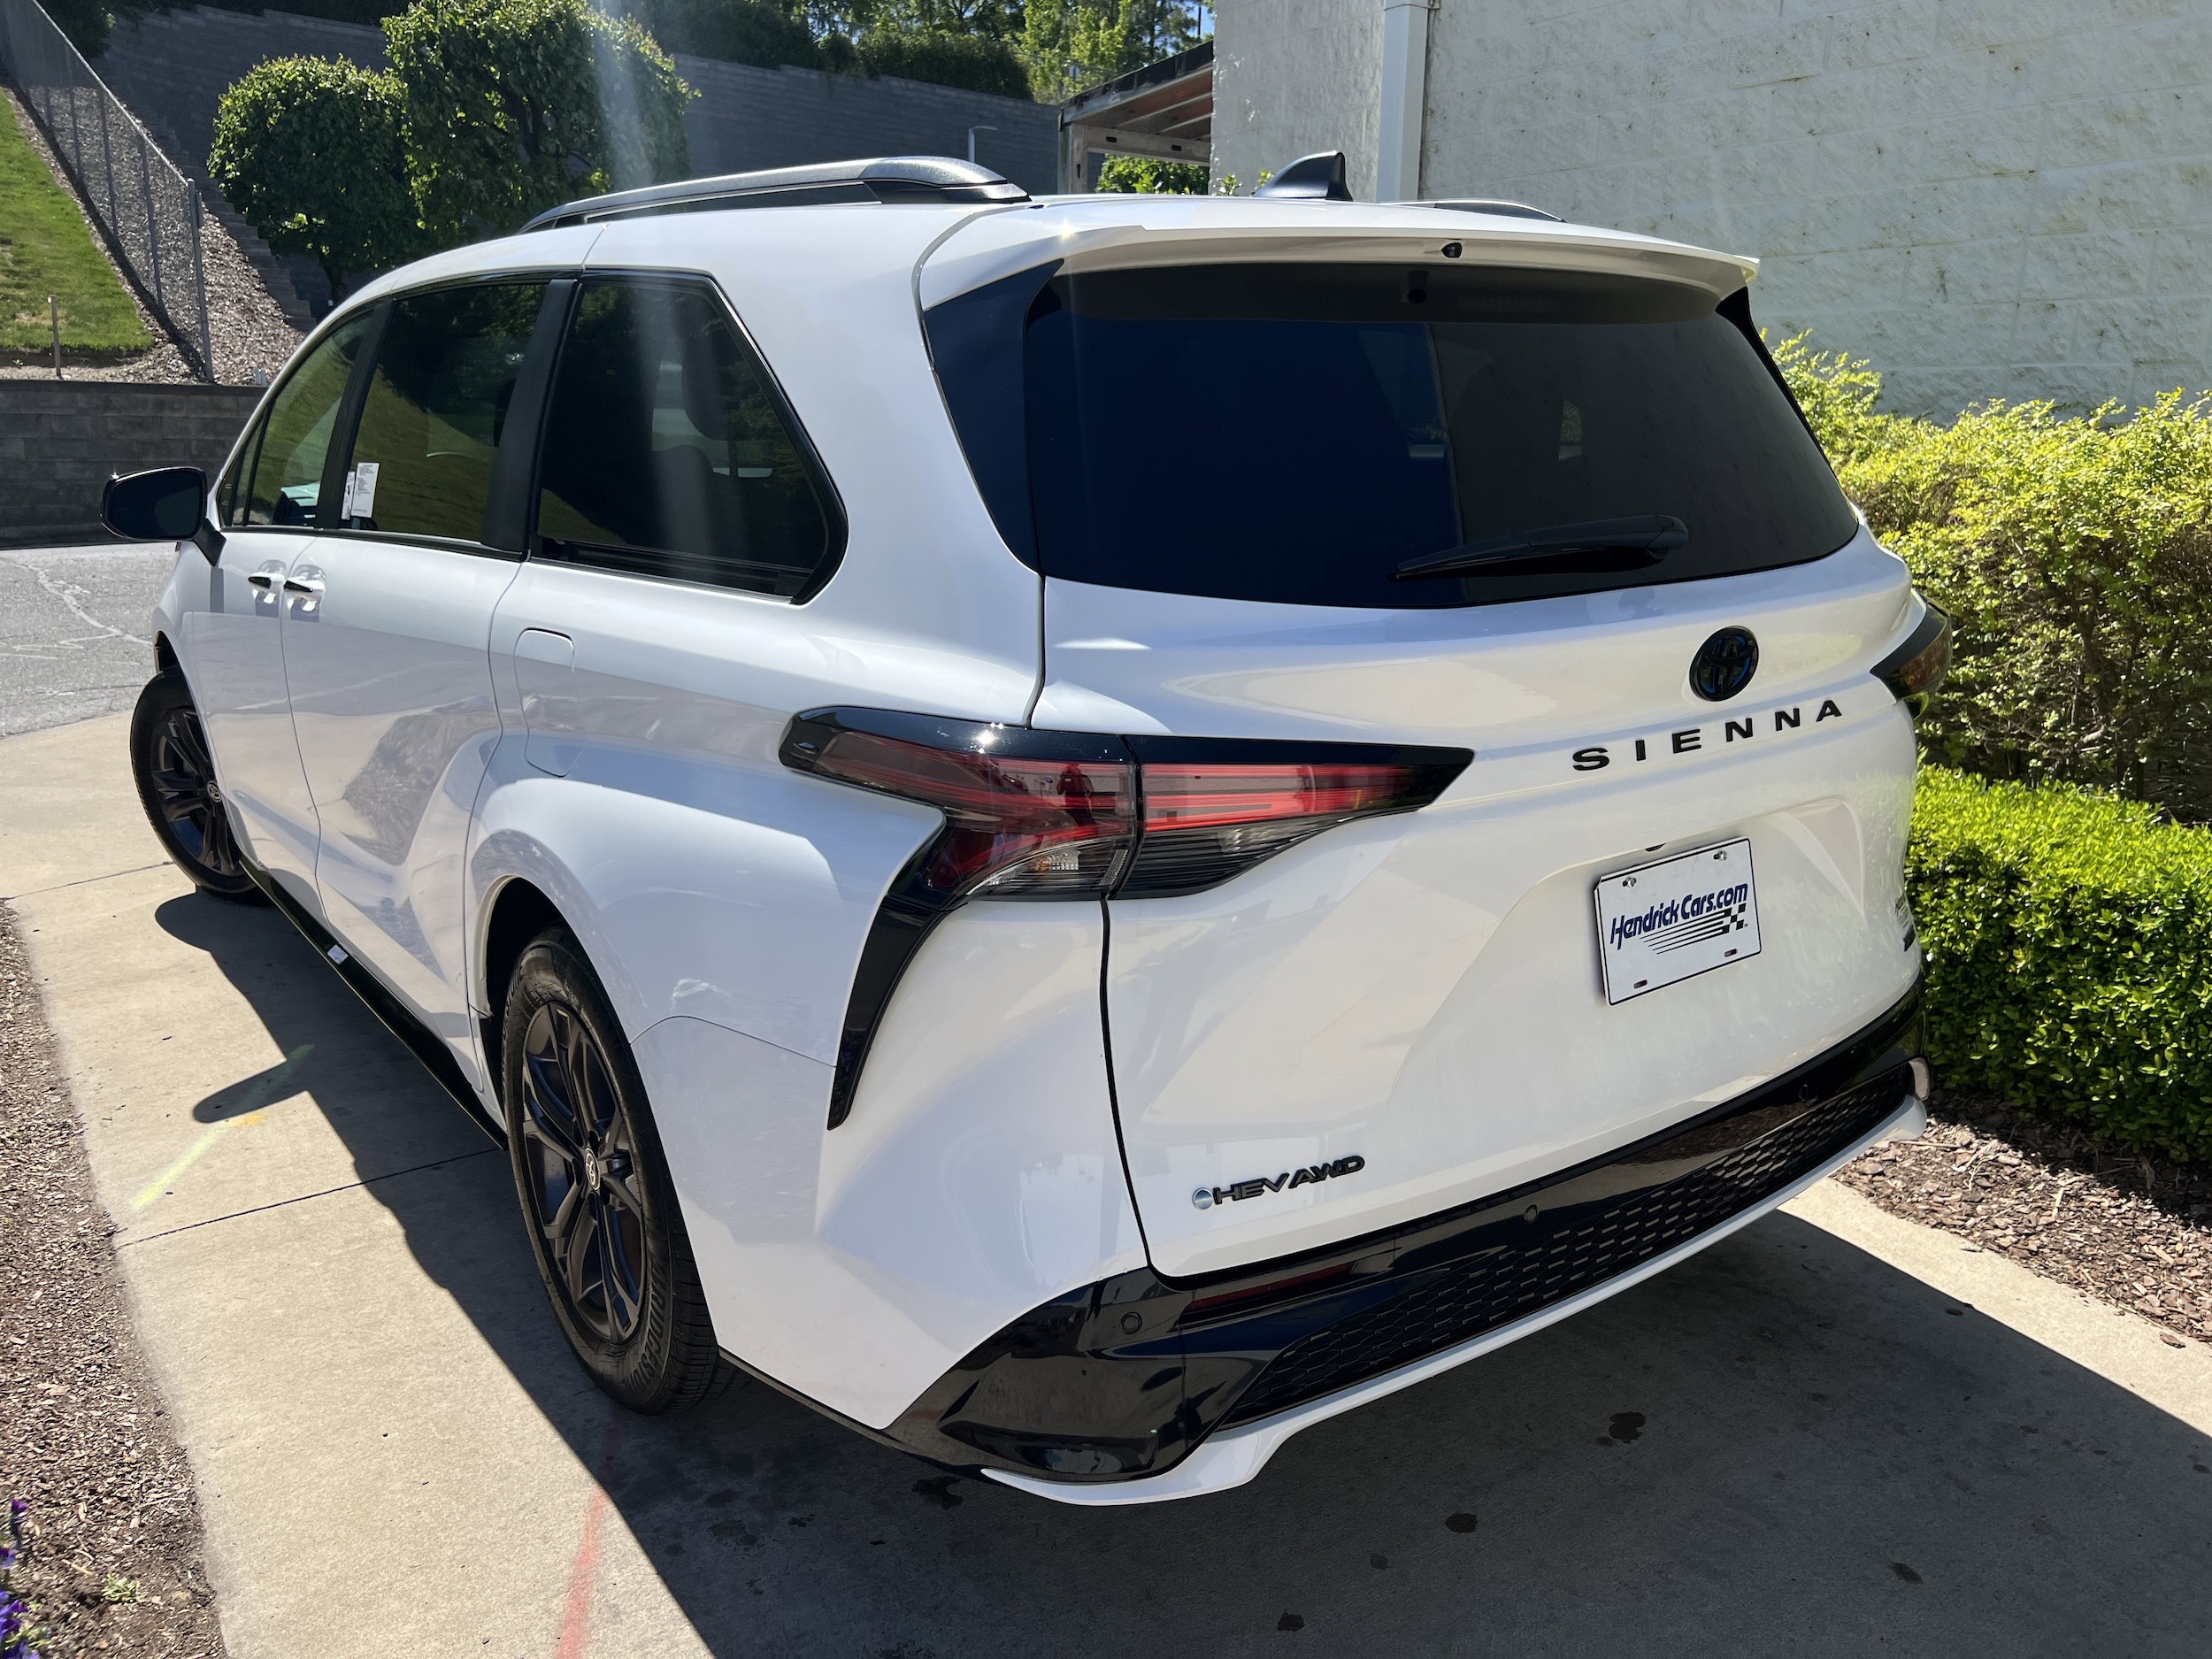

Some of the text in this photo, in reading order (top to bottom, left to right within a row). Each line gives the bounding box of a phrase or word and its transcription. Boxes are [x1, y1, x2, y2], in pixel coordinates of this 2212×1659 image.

[1572, 700, 1842, 772] SIENNA
[1213, 1156, 1365, 1205] HEV AWD
